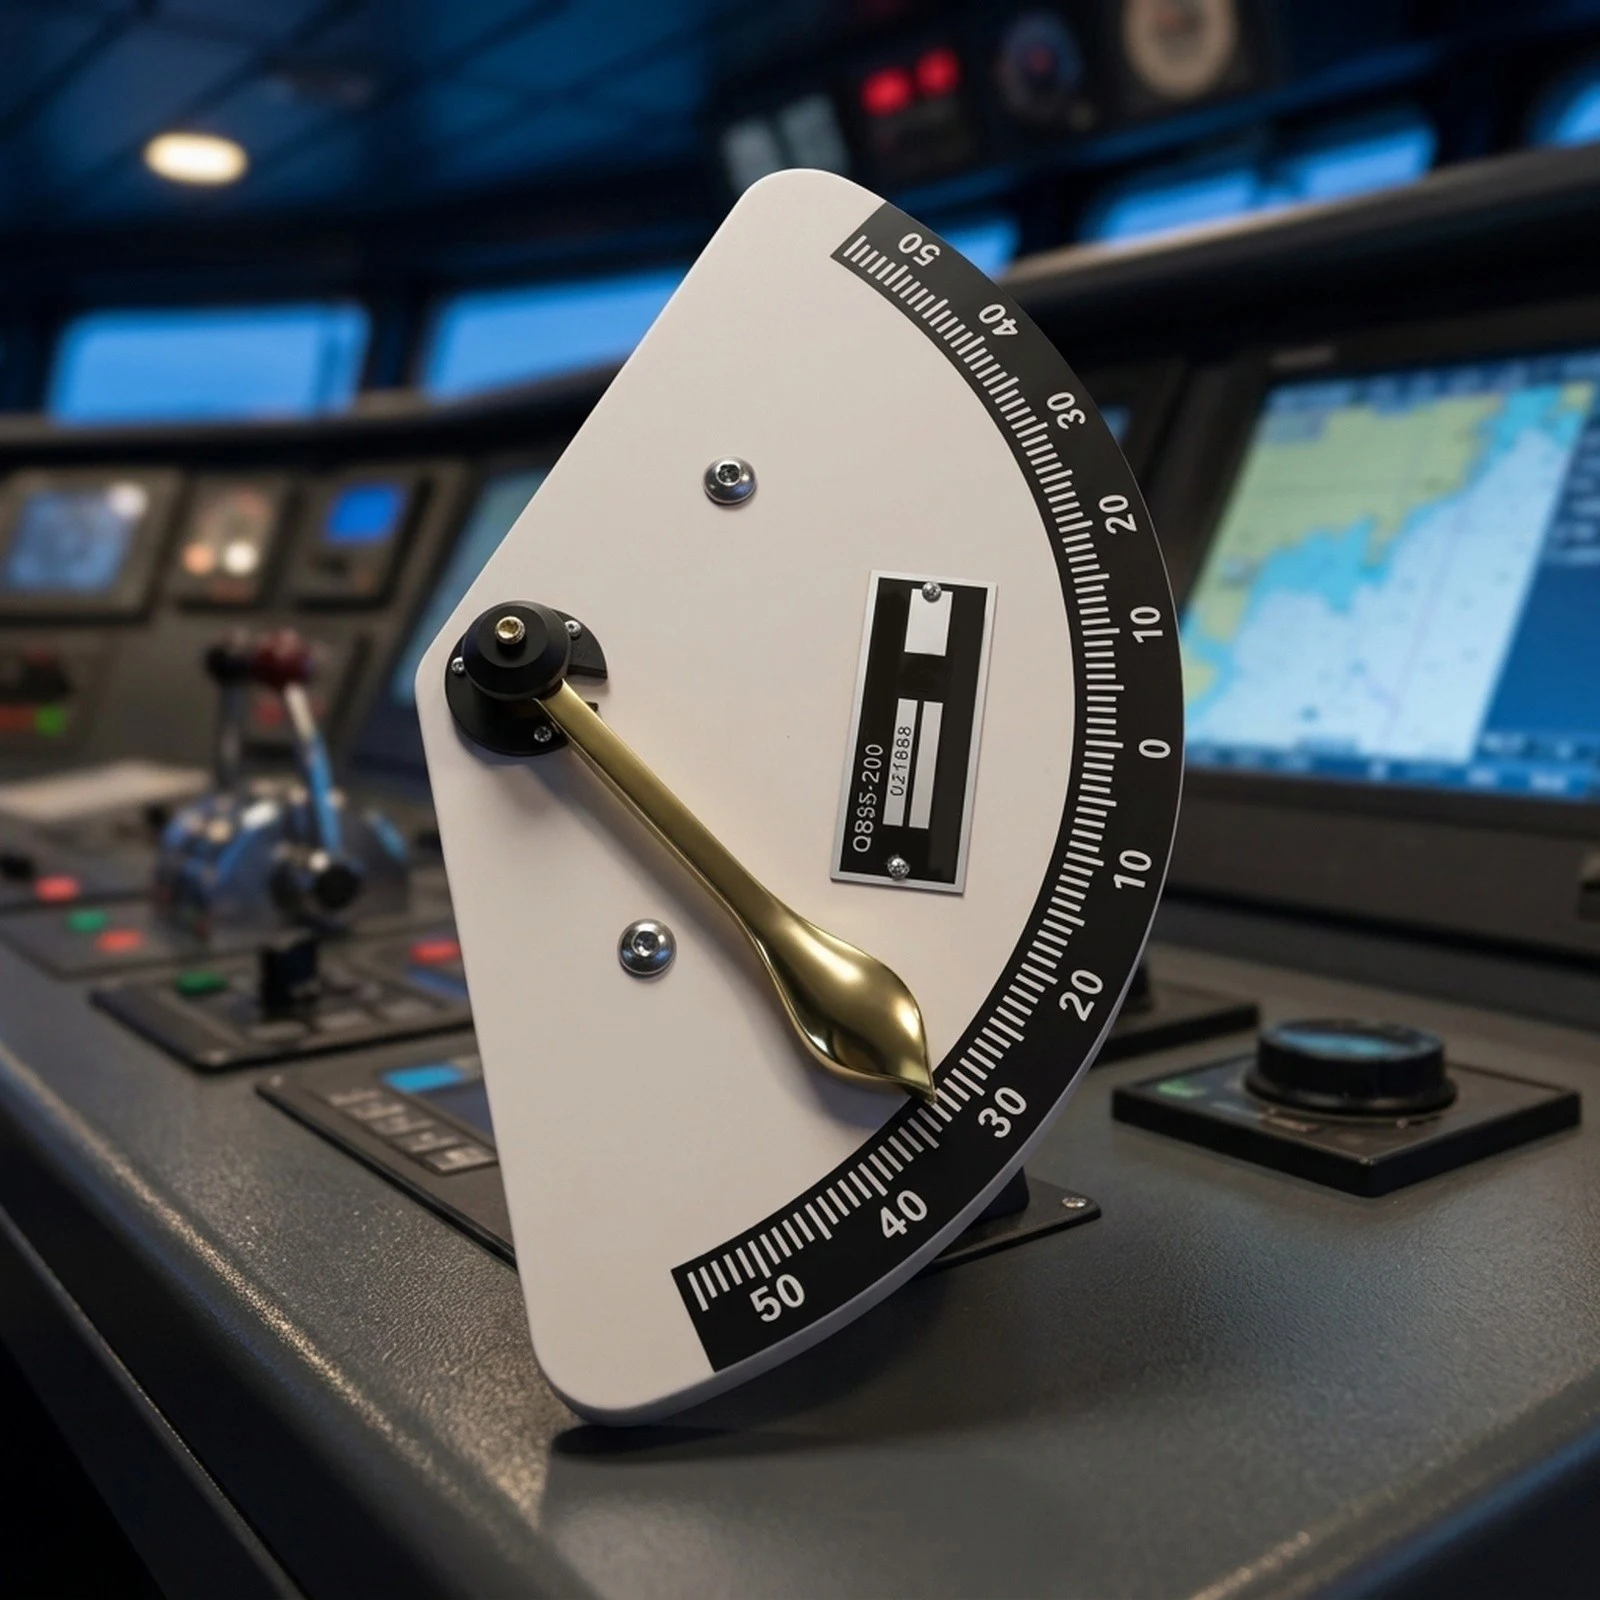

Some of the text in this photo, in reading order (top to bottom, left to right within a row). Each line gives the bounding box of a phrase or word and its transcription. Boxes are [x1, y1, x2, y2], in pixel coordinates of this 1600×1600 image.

[897, 232, 941, 267] 50
[978, 303, 1019, 336] 40
[1046, 392, 1086, 430] 30
[1098, 494, 1137, 534] 20
[1129, 606, 1164, 643] 10
[1138, 739, 1171, 759] 0
[1113, 850, 1152, 889] 10
[1059, 968, 1103, 1022] 20
[978, 1087, 1027, 1138] 30
[880, 1190, 928, 1239] 40
[749, 1274, 805, 1322] 50
